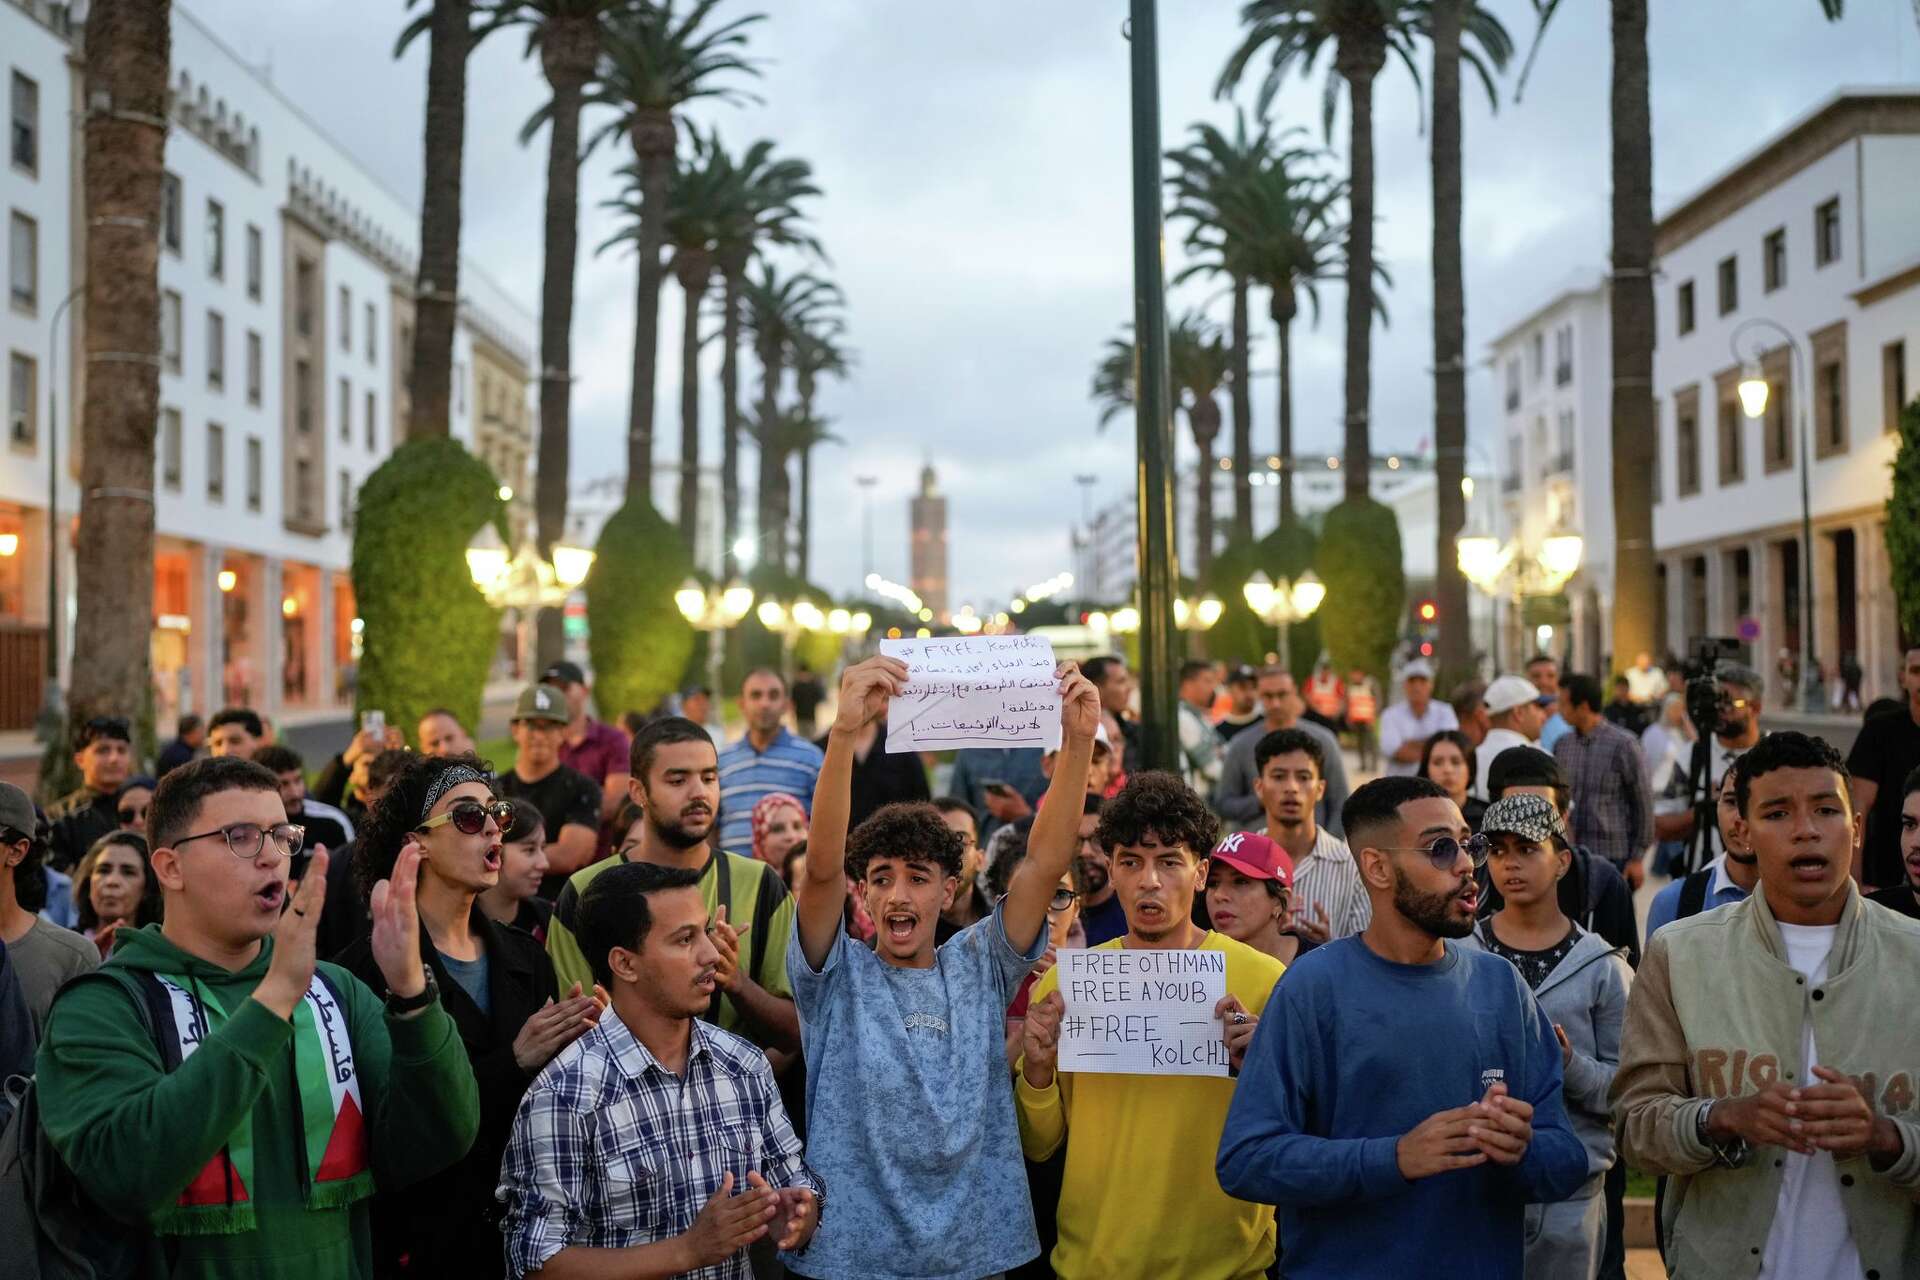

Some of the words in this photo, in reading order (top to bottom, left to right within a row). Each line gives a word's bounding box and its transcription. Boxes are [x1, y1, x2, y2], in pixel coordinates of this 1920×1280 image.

[1028, 715, 1041, 730] لا
[1216, 832, 1245, 853] NY
[1071, 953, 1132, 975] FREE
[1138, 952, 1225, 974] OTHMAN
[1071, 980, 1132, 1002] FREE
[1141, 980, 1208, 1004] AYOUB
[1151, 1039, 1230, 1068] KOLCHI
